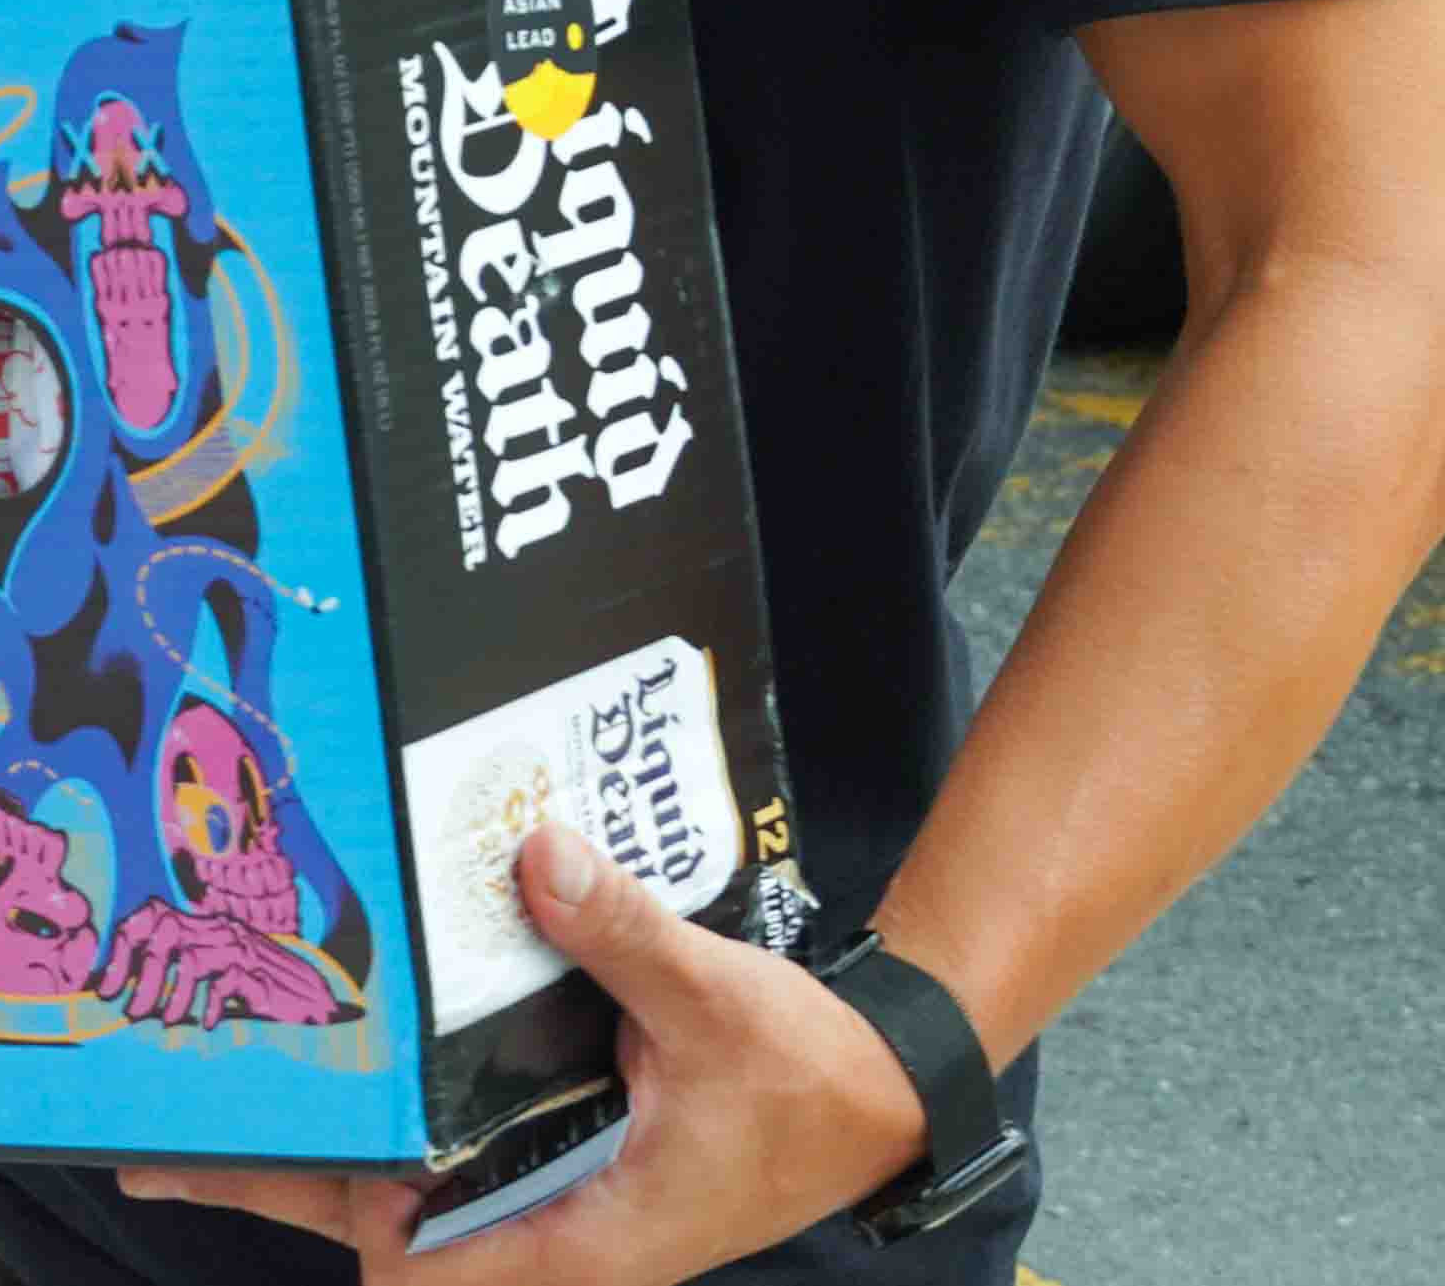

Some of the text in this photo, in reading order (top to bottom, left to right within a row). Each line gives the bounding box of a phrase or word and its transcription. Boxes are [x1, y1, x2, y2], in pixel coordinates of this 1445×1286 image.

[505, 27, 557, 51] LEAD
[398, 54, 489, 572] MOUNTAIN WATER
[432, 40, 597, 560] Death
[590, 691, 658, 880] Deat
[634, 657, 706, 886] Liquid
[753, 797, 789, 861] 12
